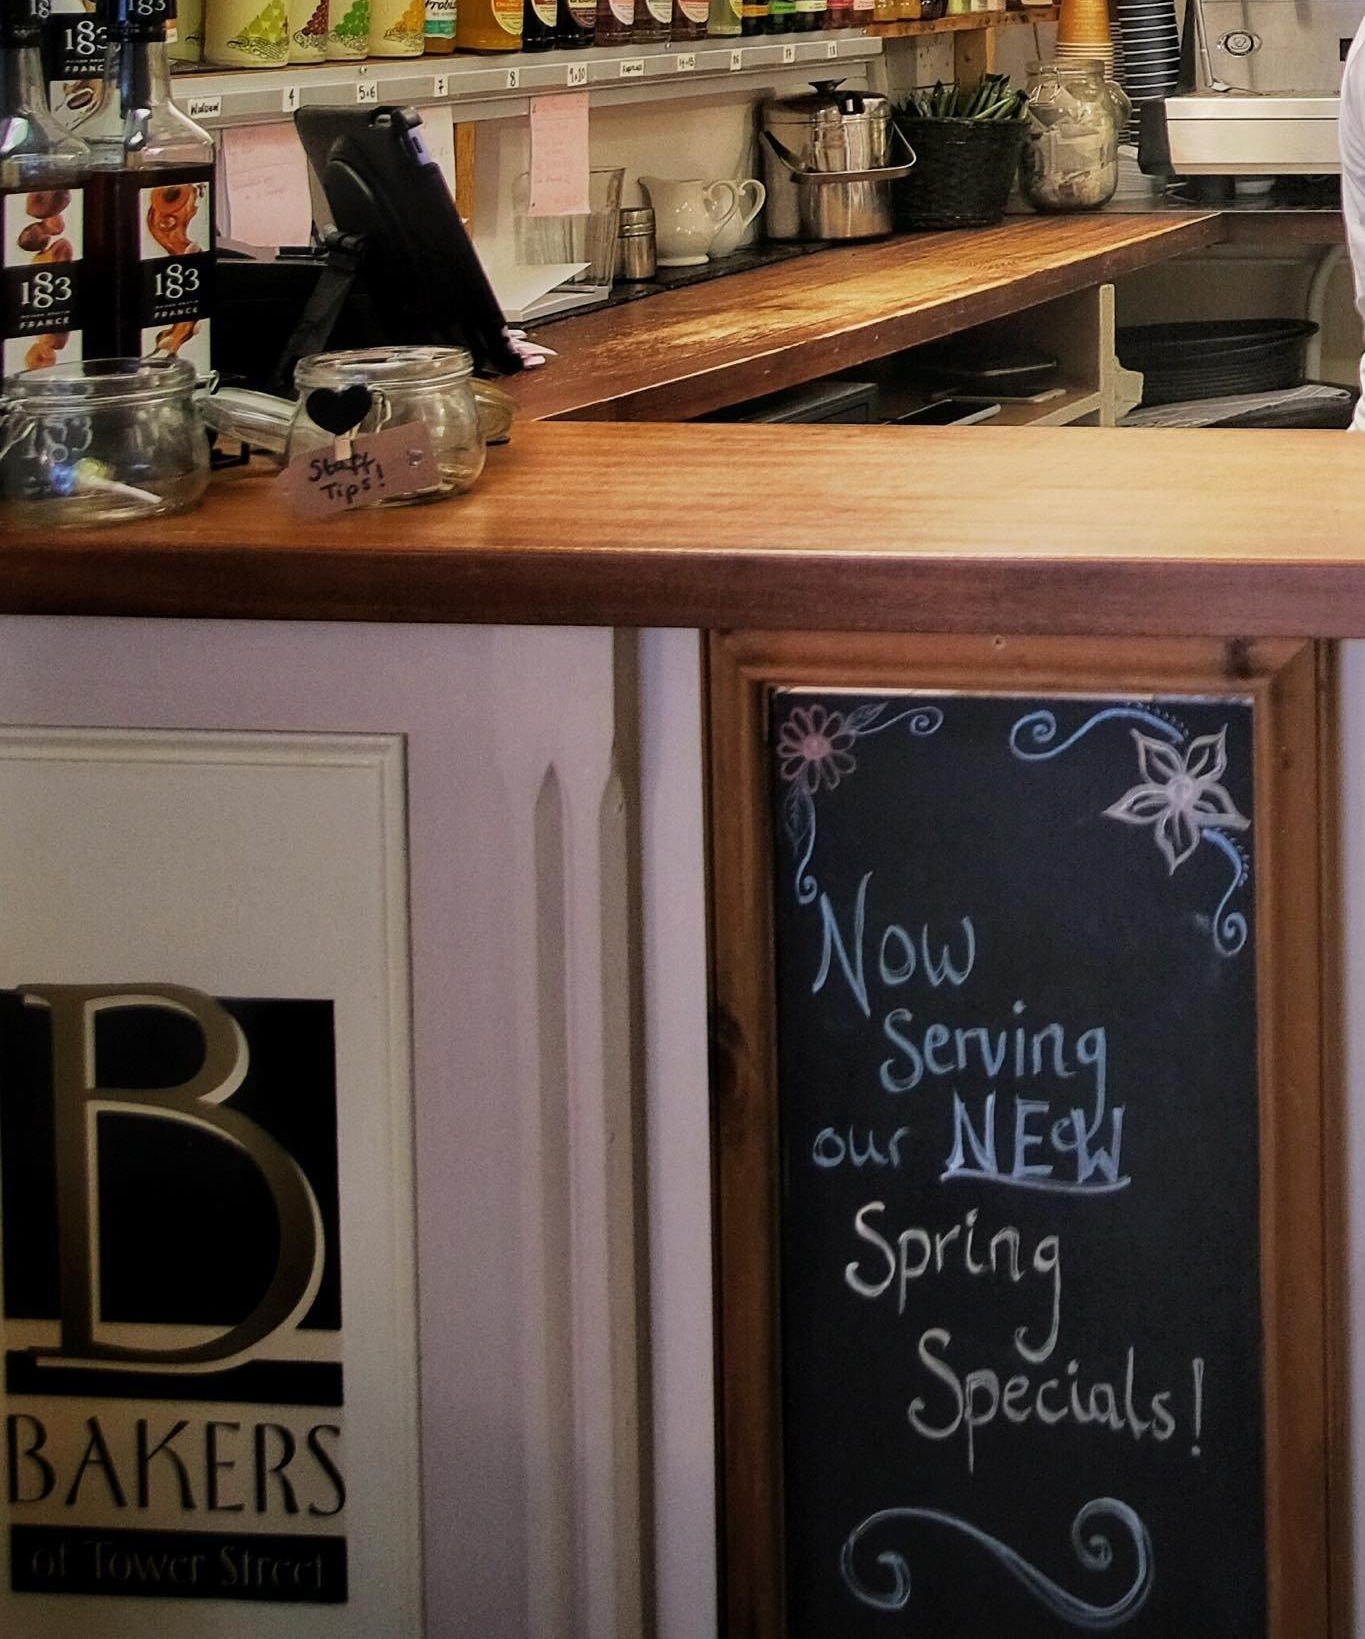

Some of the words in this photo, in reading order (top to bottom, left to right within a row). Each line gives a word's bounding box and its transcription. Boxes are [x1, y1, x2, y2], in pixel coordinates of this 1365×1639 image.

[811, 871, 976, 1018] Now
[811, 1123, 906, 1171] our
[940, 1090, 1132, 1188] NEW
[879, 1000, 1110, 1150] Serving
[13, 980, 328, 1376] B
[845, 1200, 1063, 1363] Spring
[6, 1412, 348, 1517] BAKERS
[907, 1326, 1208, 1474] Specials!
[30, 1541, 70, 1580] of
[84, 1537, 206, 1588] Tower
[218, 1541, 325, 1592] Street
